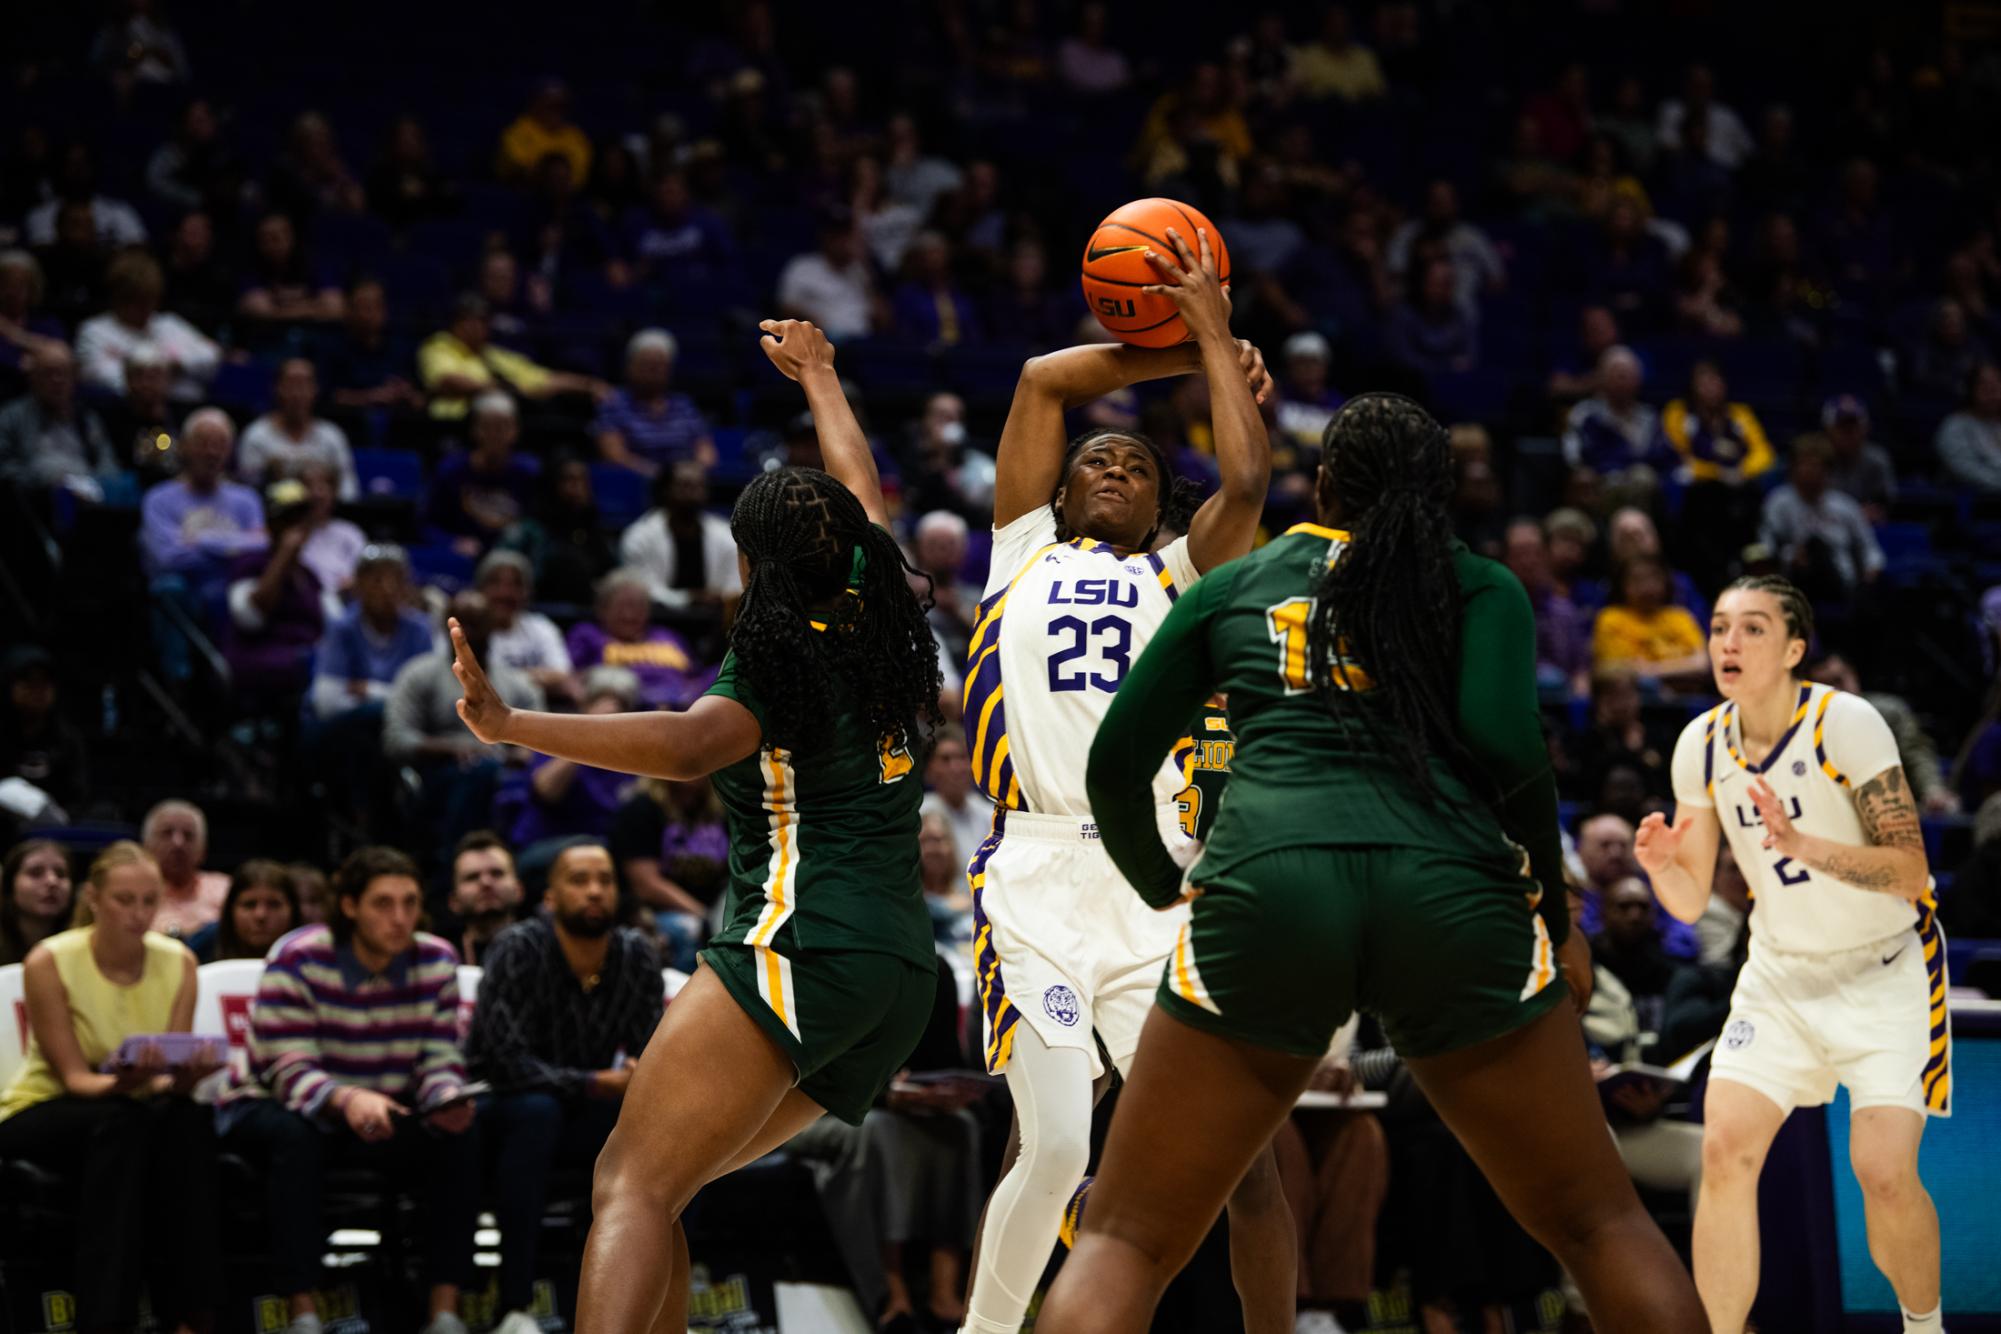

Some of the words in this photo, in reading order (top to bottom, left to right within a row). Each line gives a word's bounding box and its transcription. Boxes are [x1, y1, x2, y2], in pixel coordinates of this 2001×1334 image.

[1087, 291, 1137, 318] LSU
[1047, 579, 1139, 609] LSU
[1047, 614, 1133, 694] 23
[1735, 795, 1803, 828] LU
